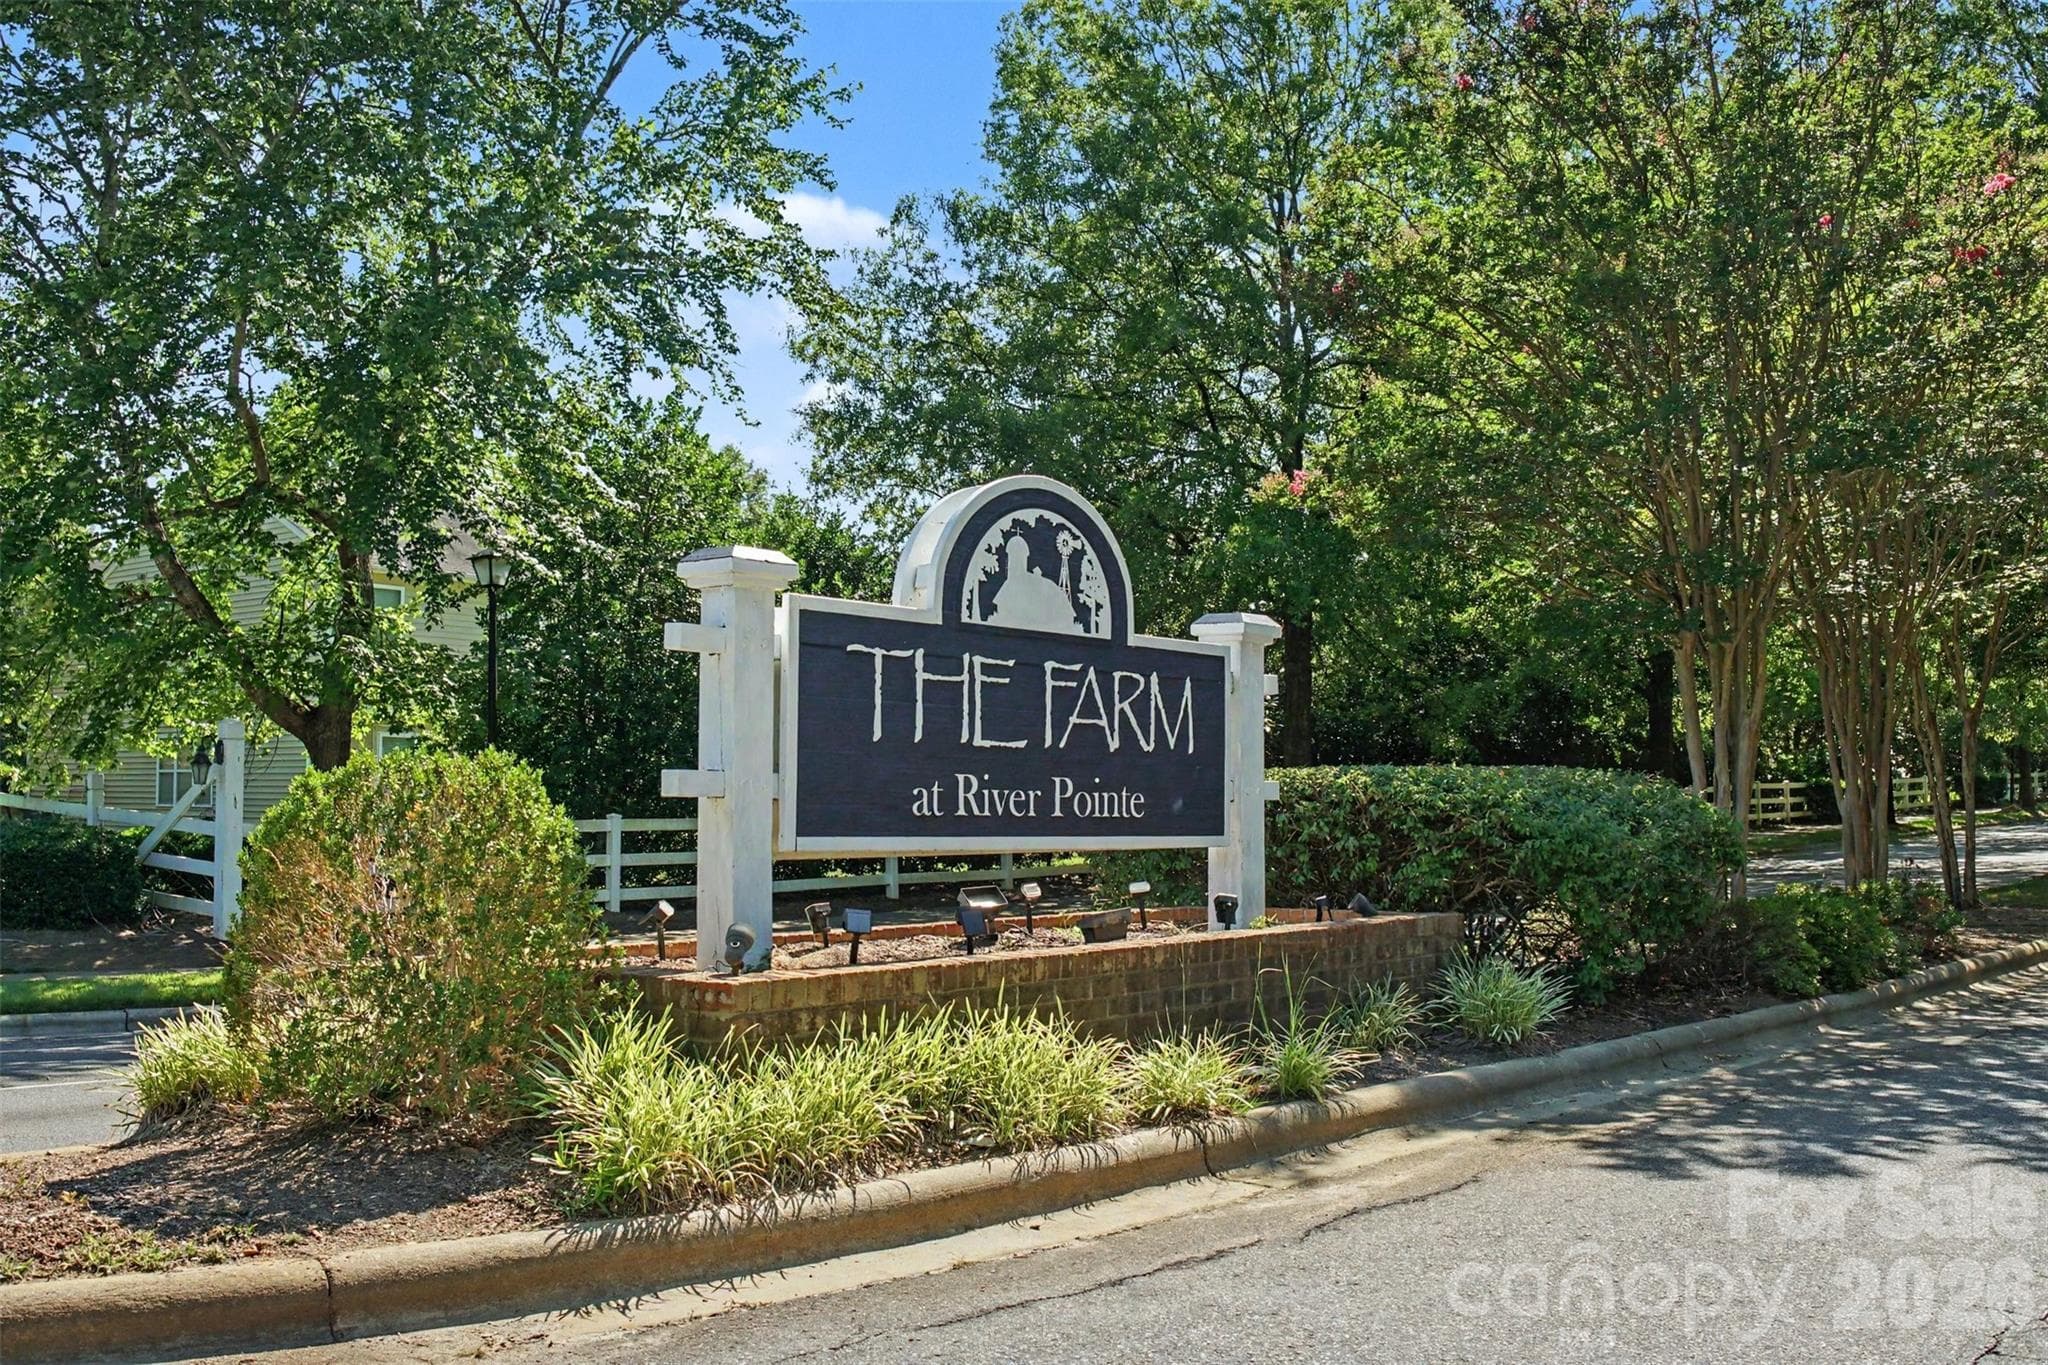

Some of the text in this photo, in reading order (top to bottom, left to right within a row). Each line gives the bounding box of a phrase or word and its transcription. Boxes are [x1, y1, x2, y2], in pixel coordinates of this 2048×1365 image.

[847, 644, 1193, 754] THE FARM
[913, 774, 1144, 817] at River Pointe
